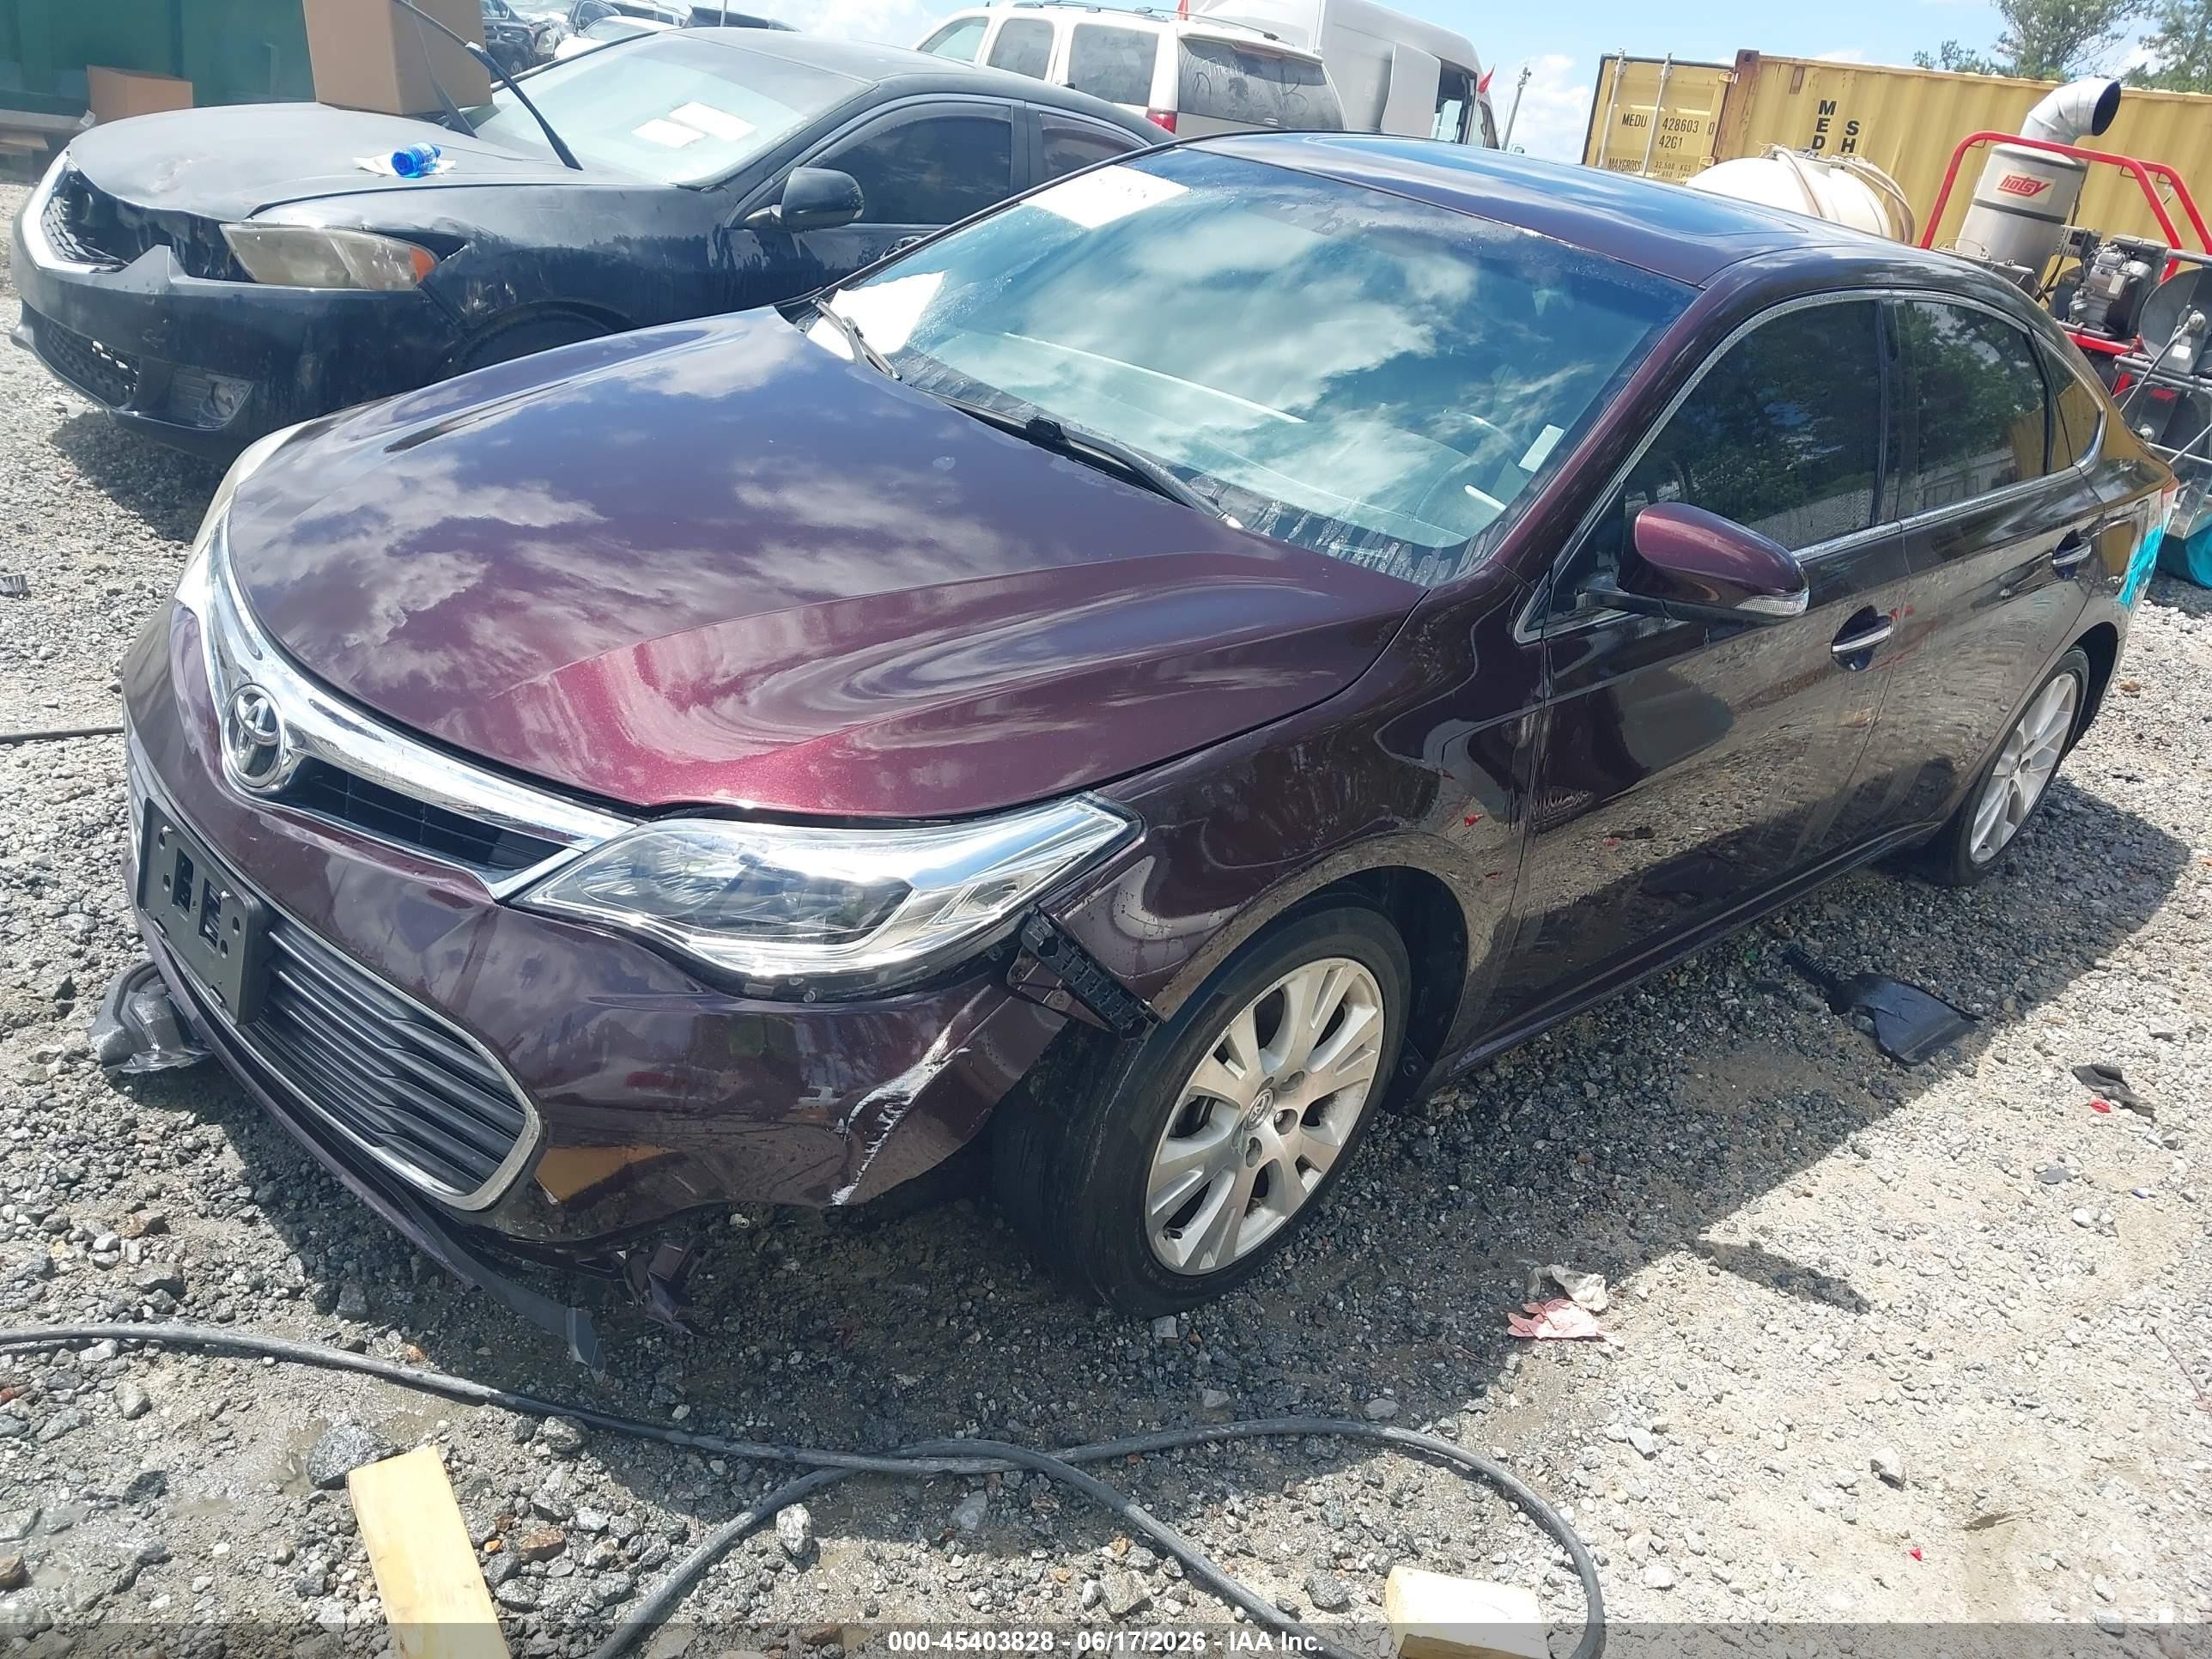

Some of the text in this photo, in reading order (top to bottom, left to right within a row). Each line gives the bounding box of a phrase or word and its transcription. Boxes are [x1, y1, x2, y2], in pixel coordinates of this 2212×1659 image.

[1621, 112, 1649, 128] MEDU
[1662, 117, 1700, 134] 428603
[1658, 135, 1684, 149] 42G1
[1607, 157, 1643, 173] MAXGROSS
